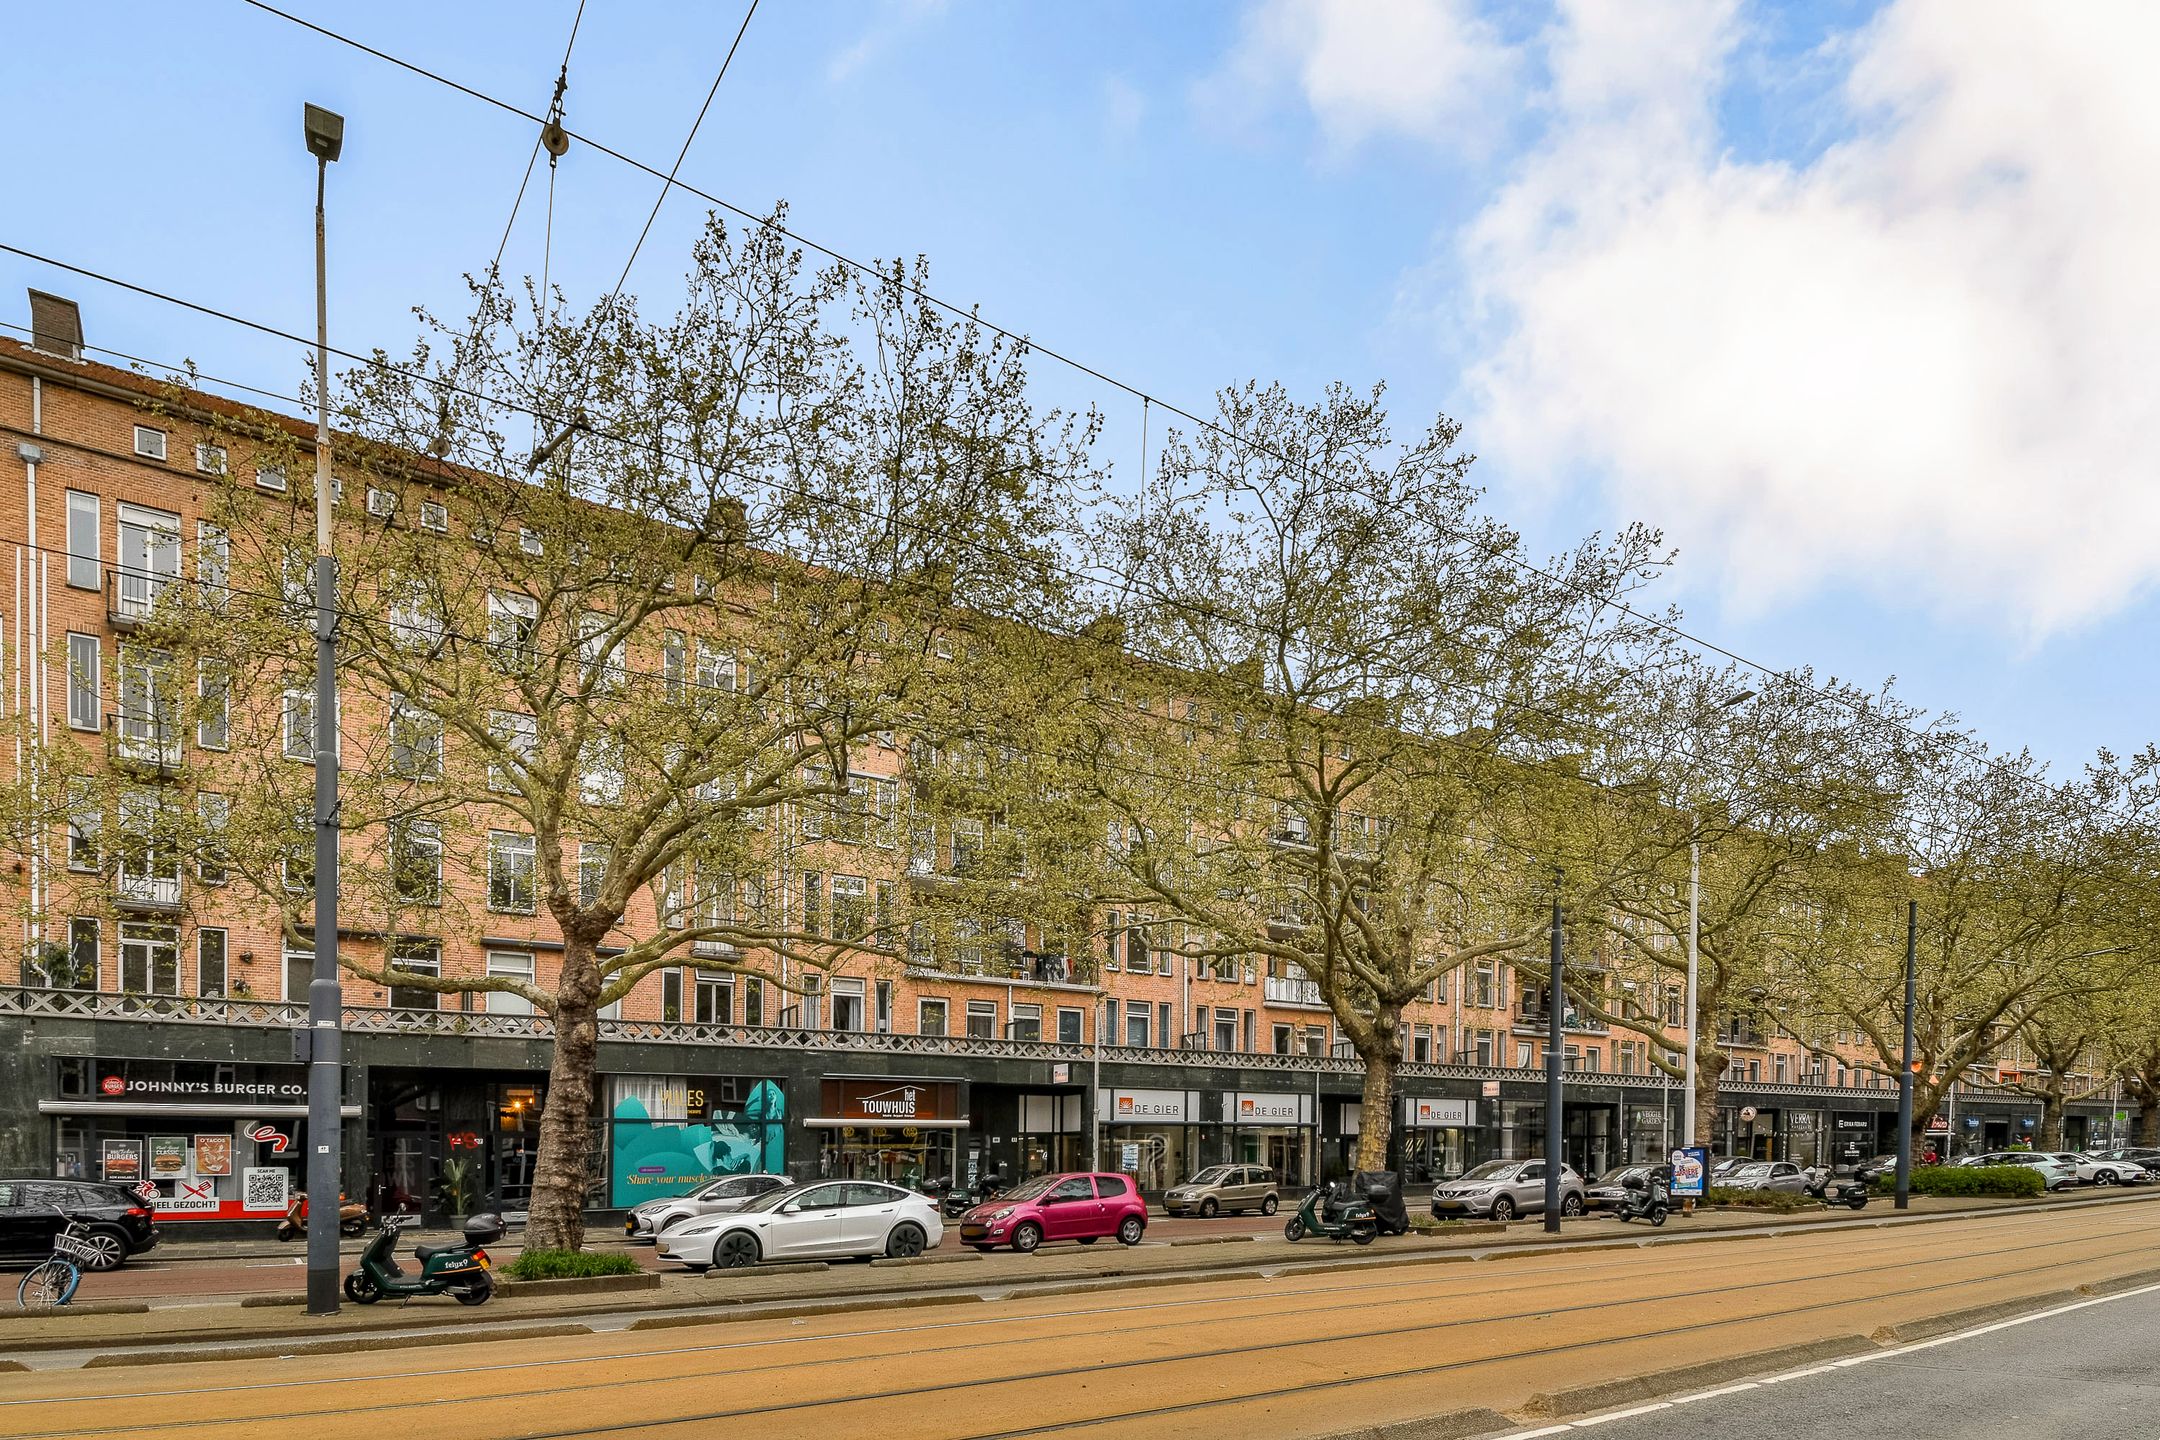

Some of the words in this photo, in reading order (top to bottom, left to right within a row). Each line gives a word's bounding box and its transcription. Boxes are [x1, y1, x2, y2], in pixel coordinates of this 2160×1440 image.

[126, 1080, 209, 1093] JOHNNY'S
[214, 1083, 276, 1094] BURGER
[280, 1084, 307, 1095] CO.
[904, 1088, 915, 1101] het
[862, 1100, 915, 1114] TOUWHUIS
[1134, 1104, 1148, 1113] DE
[1153, 1104, 1179, 1114] GIER
[1255, 1107, 1267, 1115] DE
[1271, 1107, 1294, 1116] GIER
[1431, 1111, 1441, 1119] DE
[1444, 1111, 1462, 1119] GIER
[656, 1176, 675, 1186] your
[173, 1200, 216, 1209] GEZOCHT!
